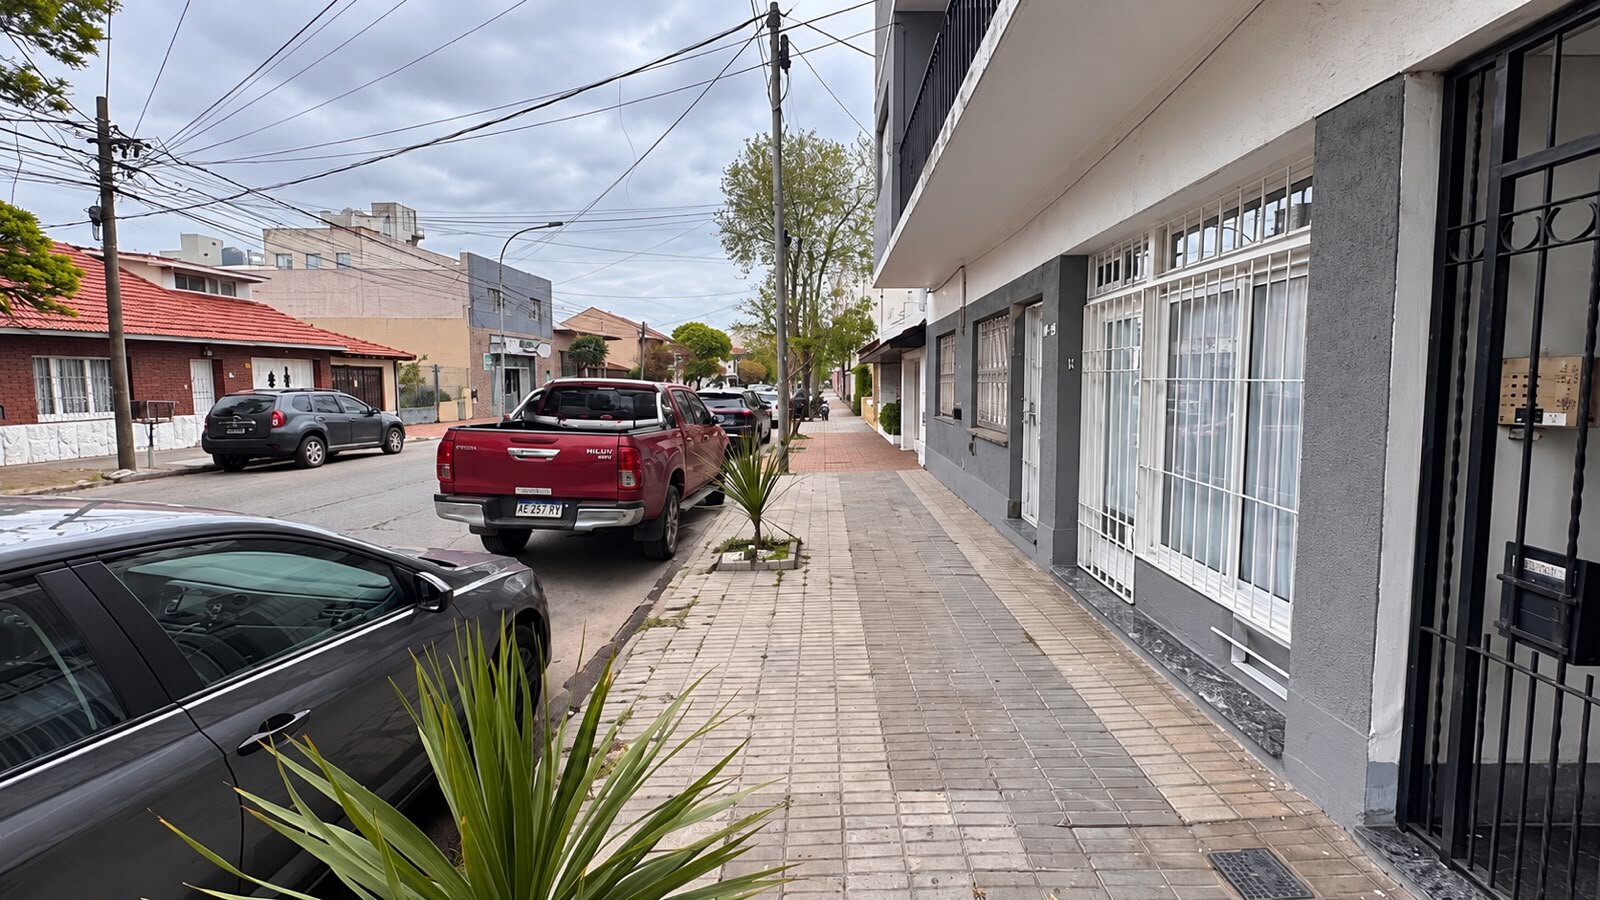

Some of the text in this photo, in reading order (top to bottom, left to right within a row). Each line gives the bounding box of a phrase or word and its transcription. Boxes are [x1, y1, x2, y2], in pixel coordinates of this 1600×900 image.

[517, 504, 561, 516] AE 257 RY
